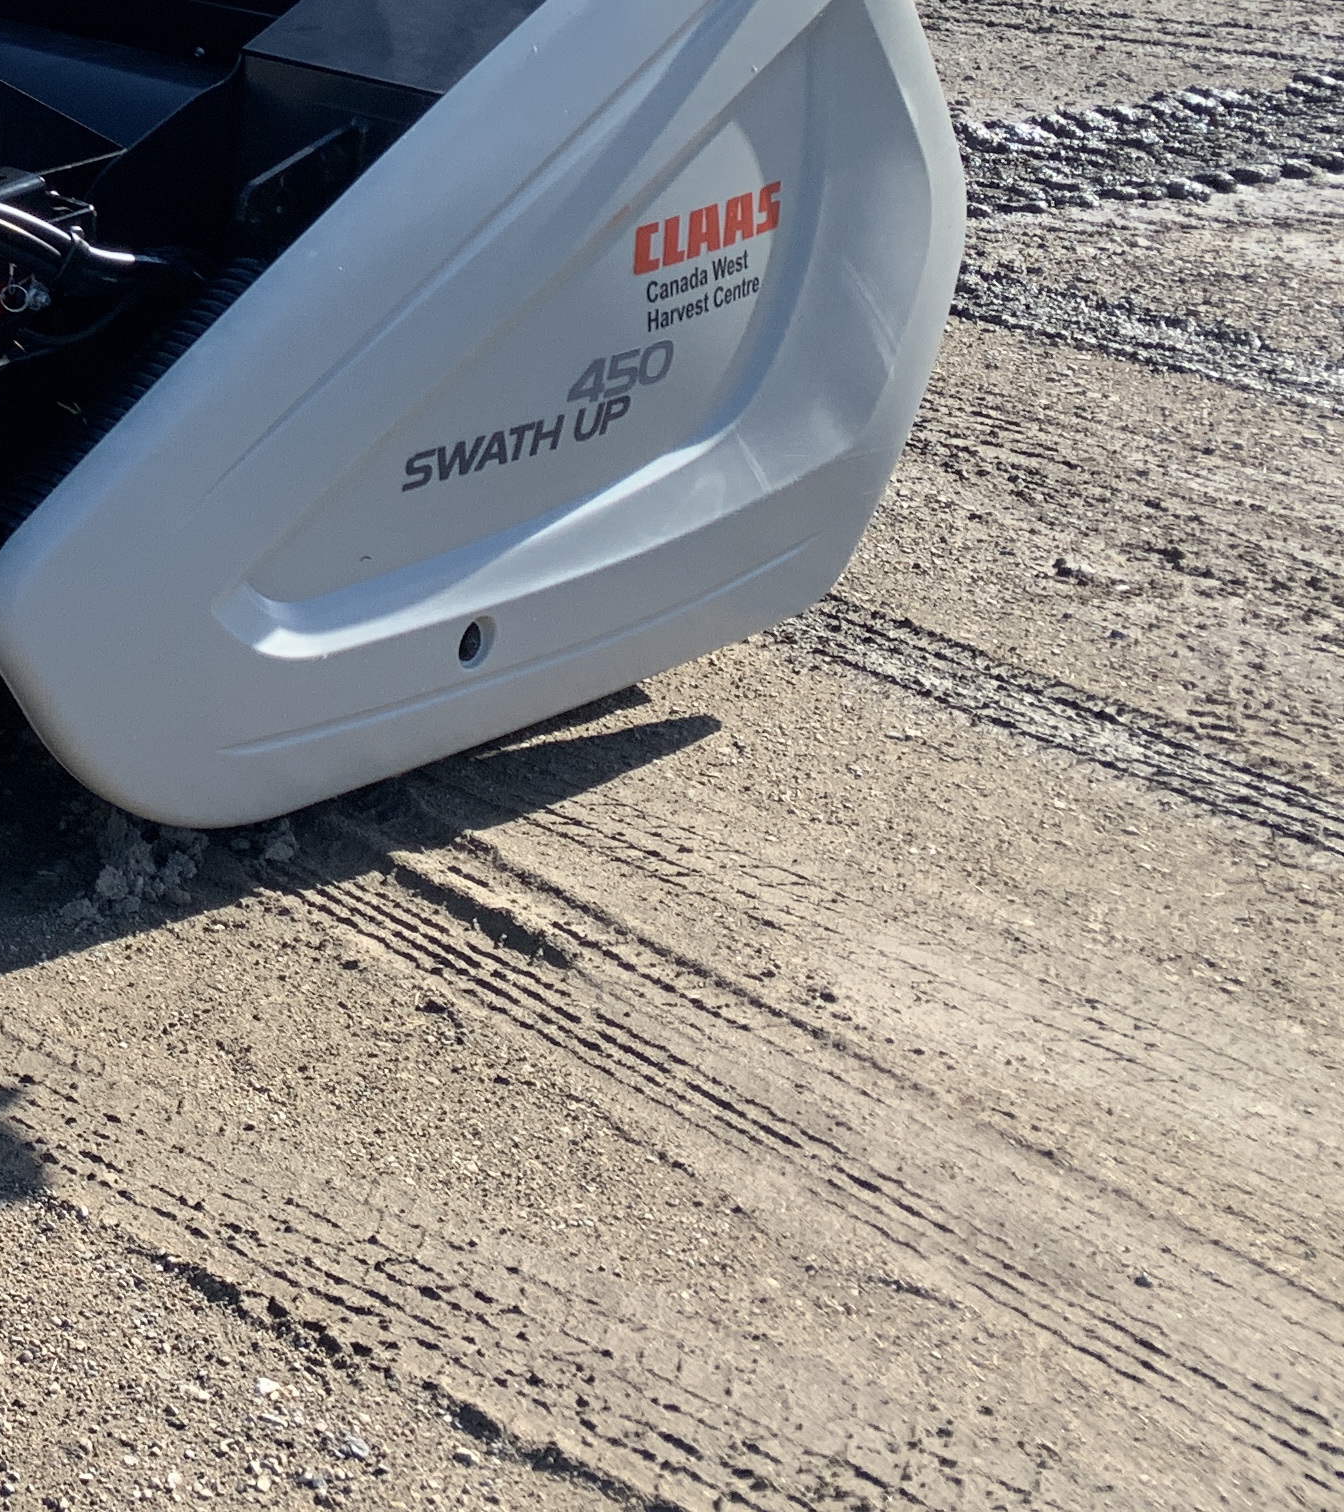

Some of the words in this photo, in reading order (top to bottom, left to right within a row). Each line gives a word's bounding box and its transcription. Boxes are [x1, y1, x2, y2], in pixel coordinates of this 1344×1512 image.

[633, 180, 782, 276] CLAAS
[646, 265, 709, 303] Canada
[712, 249, 749, 282] West
[647, 296, 710, 332] Harvest
[713, 275, 761, 309] Centre
[566, 339, 675, 404] 450
[401, 413, 565, 493] SWATH
[573, 395, 632, 443] UP
